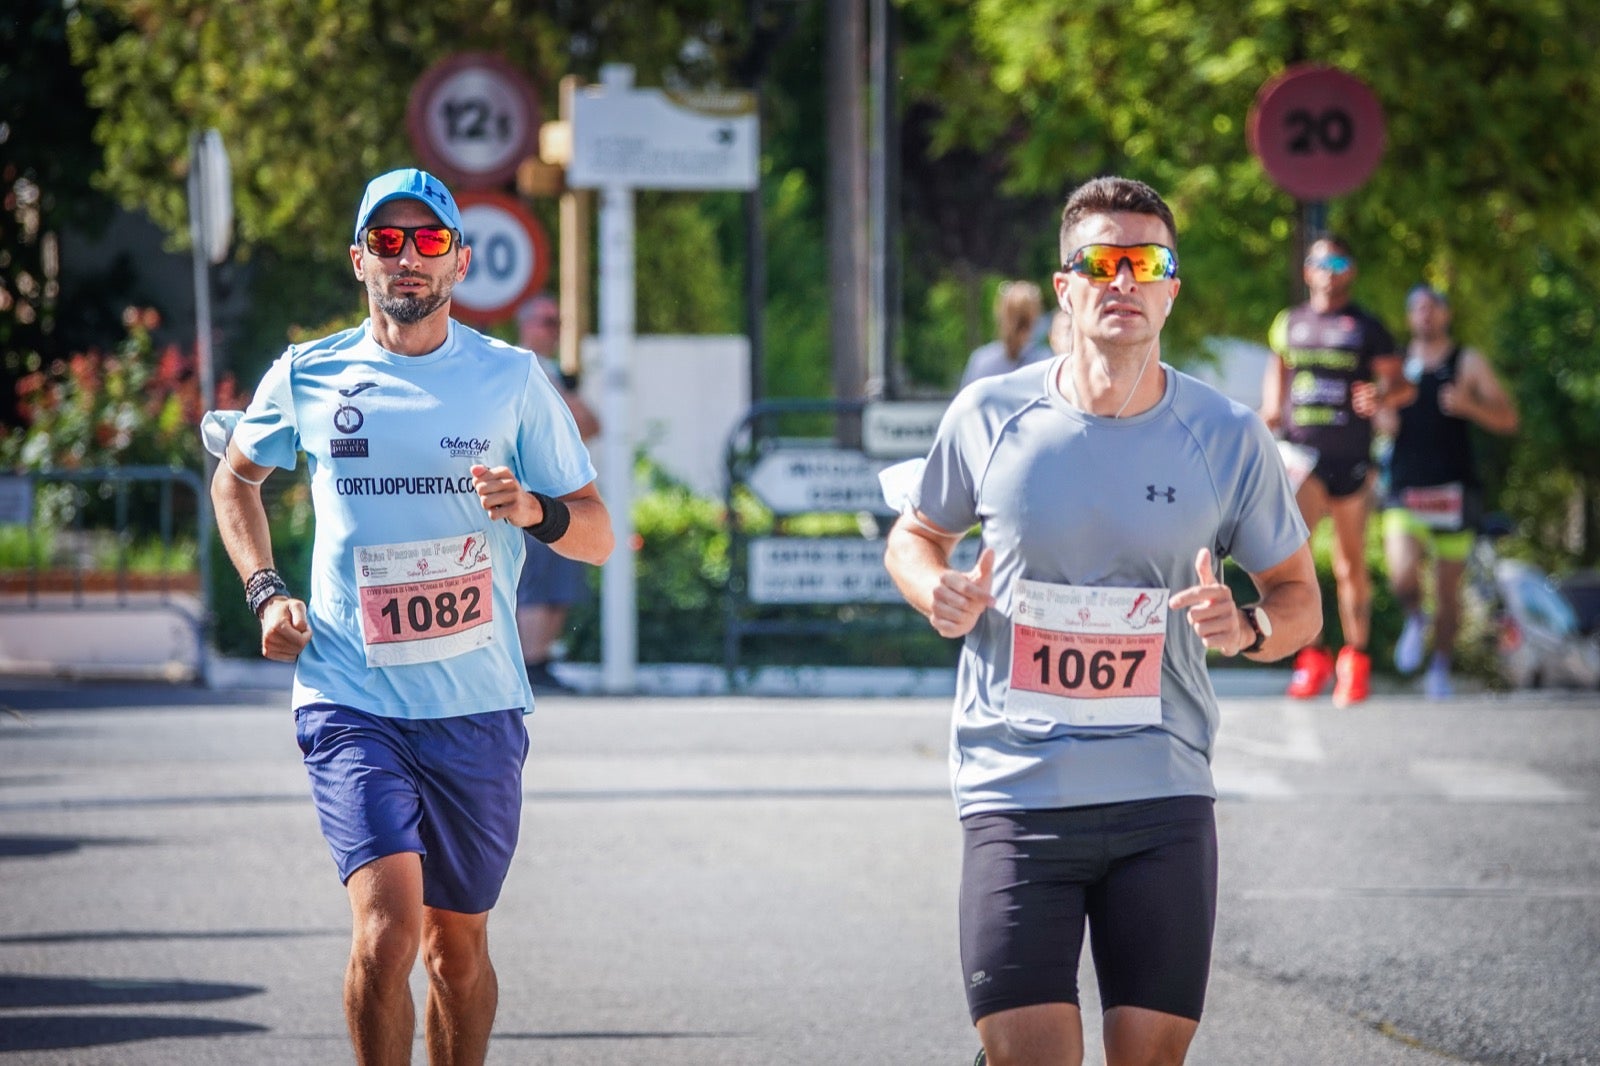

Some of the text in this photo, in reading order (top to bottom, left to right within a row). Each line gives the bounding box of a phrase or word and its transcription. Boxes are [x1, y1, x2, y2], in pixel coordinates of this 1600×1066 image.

[1284, 107, 1354, 155] 20
[336, 477, 478, 496] CORTIJOPUERTA.CO
[381, 586, 481, 635] 1082
[1033, 645, 1147, 691] 1067
